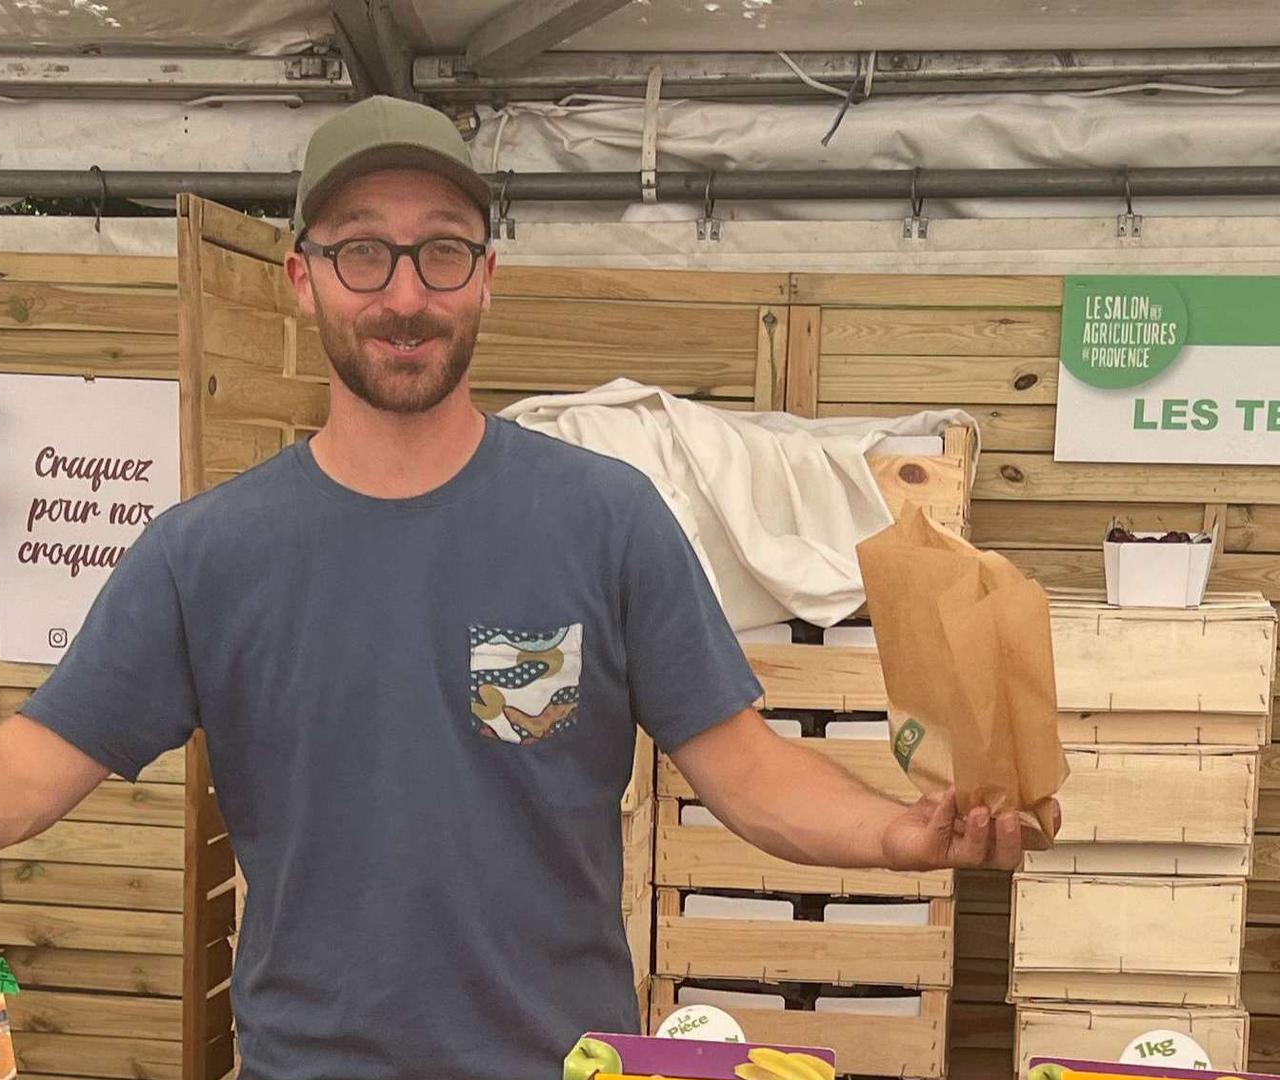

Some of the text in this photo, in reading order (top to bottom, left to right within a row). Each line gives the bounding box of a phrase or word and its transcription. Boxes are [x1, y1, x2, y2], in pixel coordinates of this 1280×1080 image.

[1086, 296, 1102, 319] LE
[1104, 295, 1150, 319] SALON
[1083, 322, 1176, 345] AGRICULTURES
[1091, 347, 1151, 368] PROVENCE
[1133, 398, 1219, 431] LES
[35, 446, 153, 492] Craquez
[27, 497, 154, 533] pour nos
[18, 541, 127, 578] croqua
[1134, 1038, 1178, 1059] 1kg
